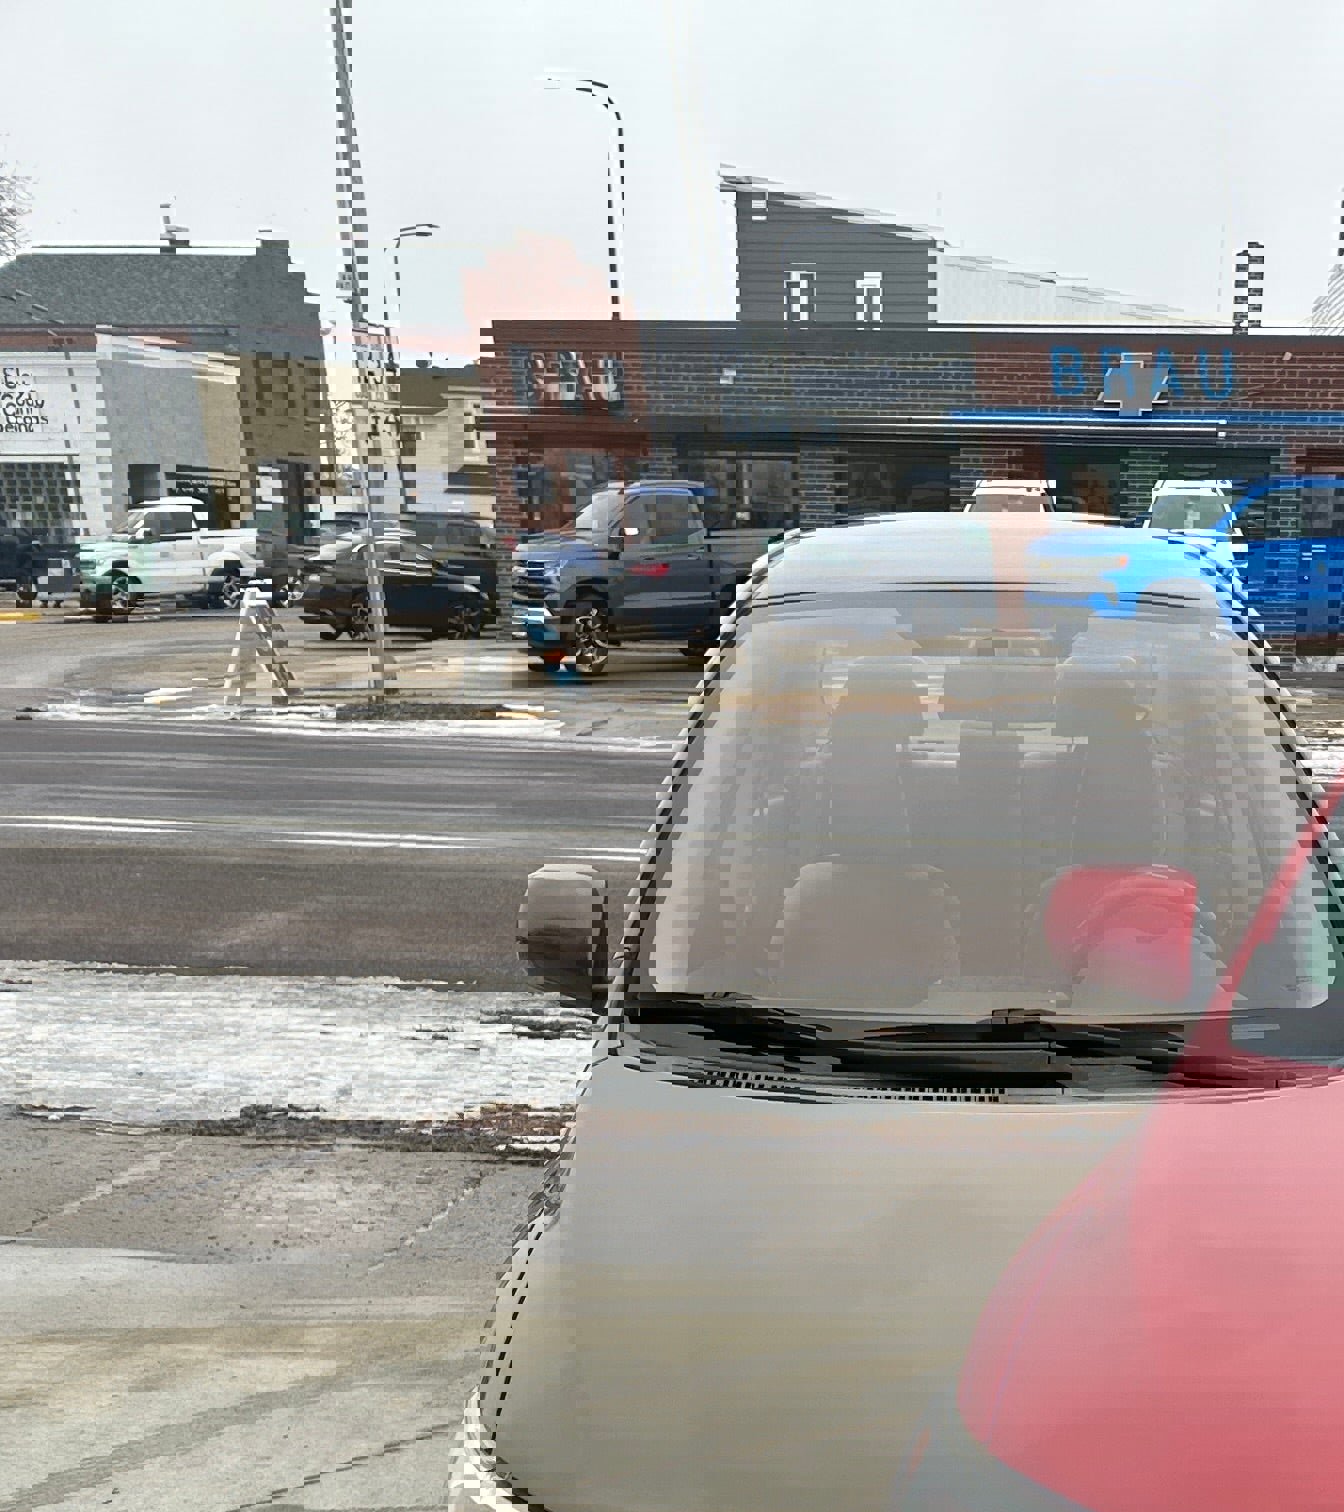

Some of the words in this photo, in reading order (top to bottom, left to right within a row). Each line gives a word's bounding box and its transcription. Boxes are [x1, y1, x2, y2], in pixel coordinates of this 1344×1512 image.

[717, 327, 740, 340] SIBLEY
[753, 332, 776, 344] SIBLEY
[721, 342, 743, 376] 12
[755, 346, 781, 381] 34
[1050, 343, 1238, 402] BRAU
[2, 364, 58, 393] Sibley
[723, 379, 747, 392] COUNTY
[759, 383, 783, 395] COUNTY
[17, 384, 77, 413] County
[5, 401, 82, 427] Seconds
